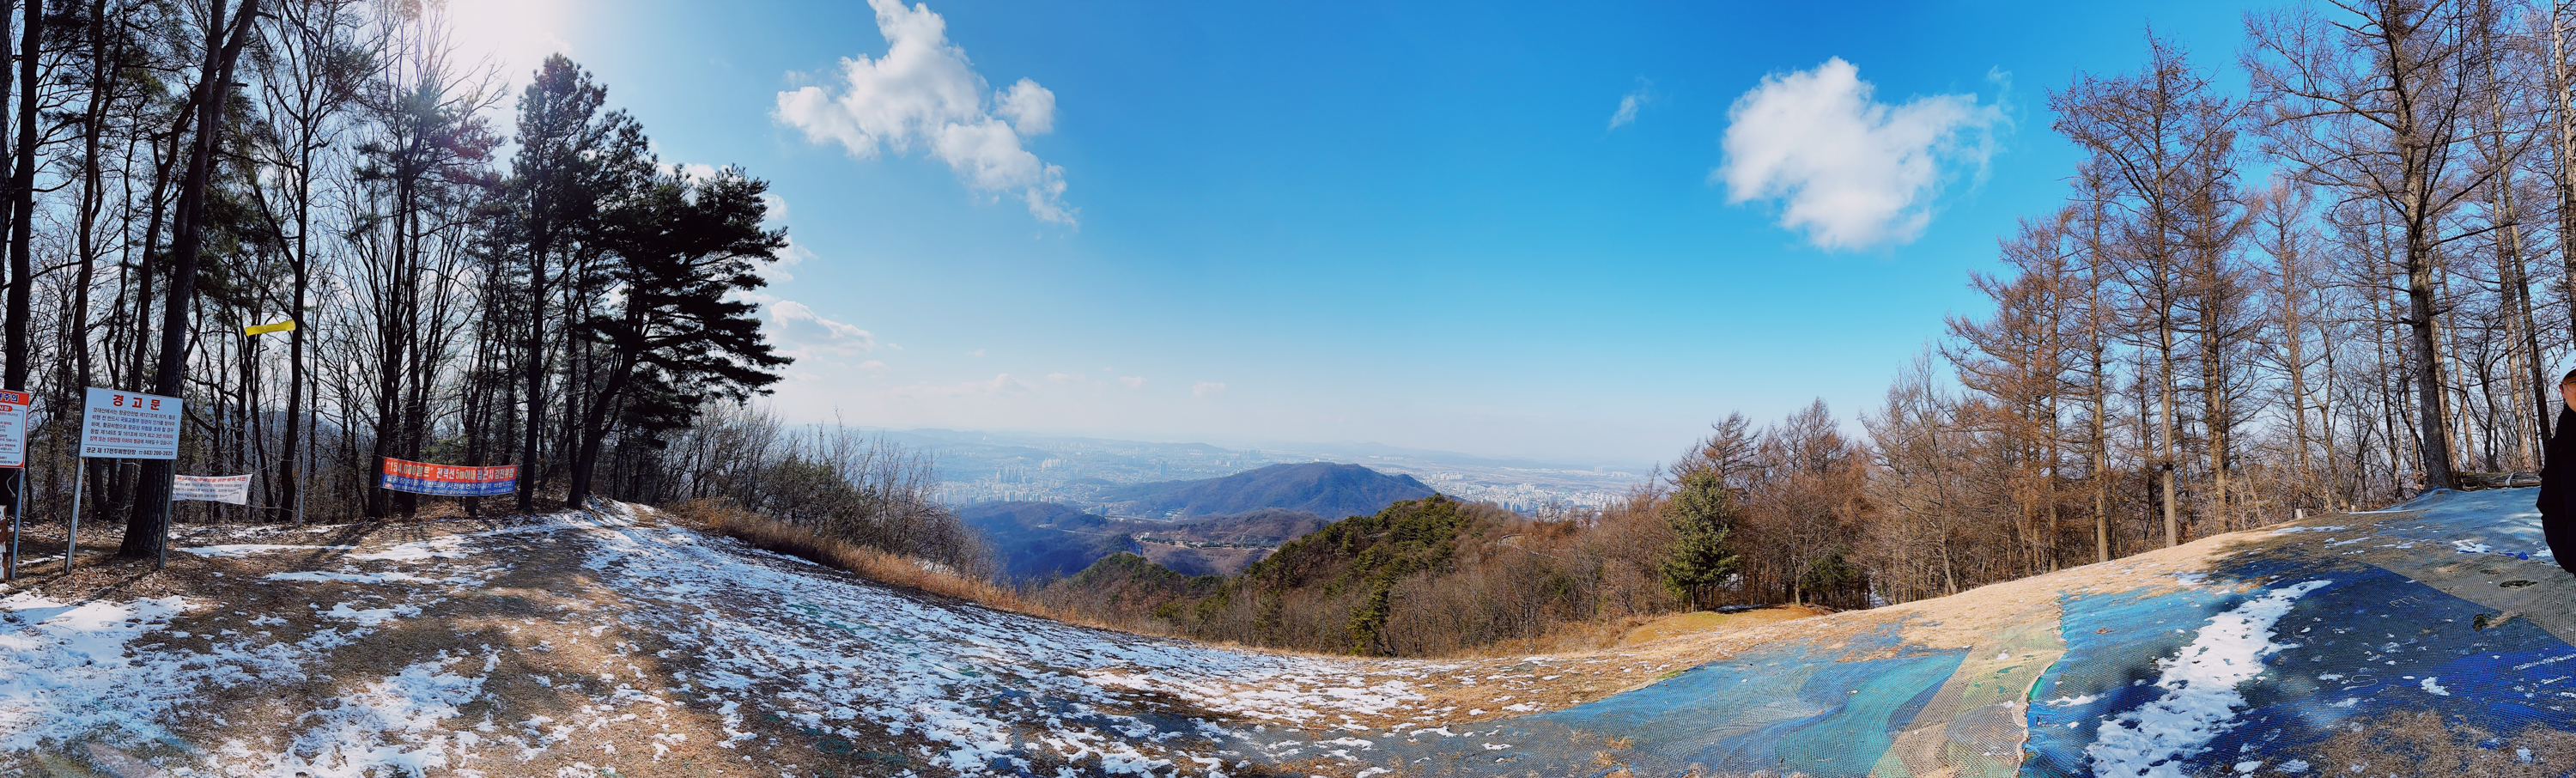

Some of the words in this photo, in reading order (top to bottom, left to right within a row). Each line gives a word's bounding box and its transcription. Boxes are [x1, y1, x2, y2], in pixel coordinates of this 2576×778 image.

[0, 392, 19, 403] 주의
[437, 467, 455, 479] 전력선
[456, 468, 476, 480] 5m이내
